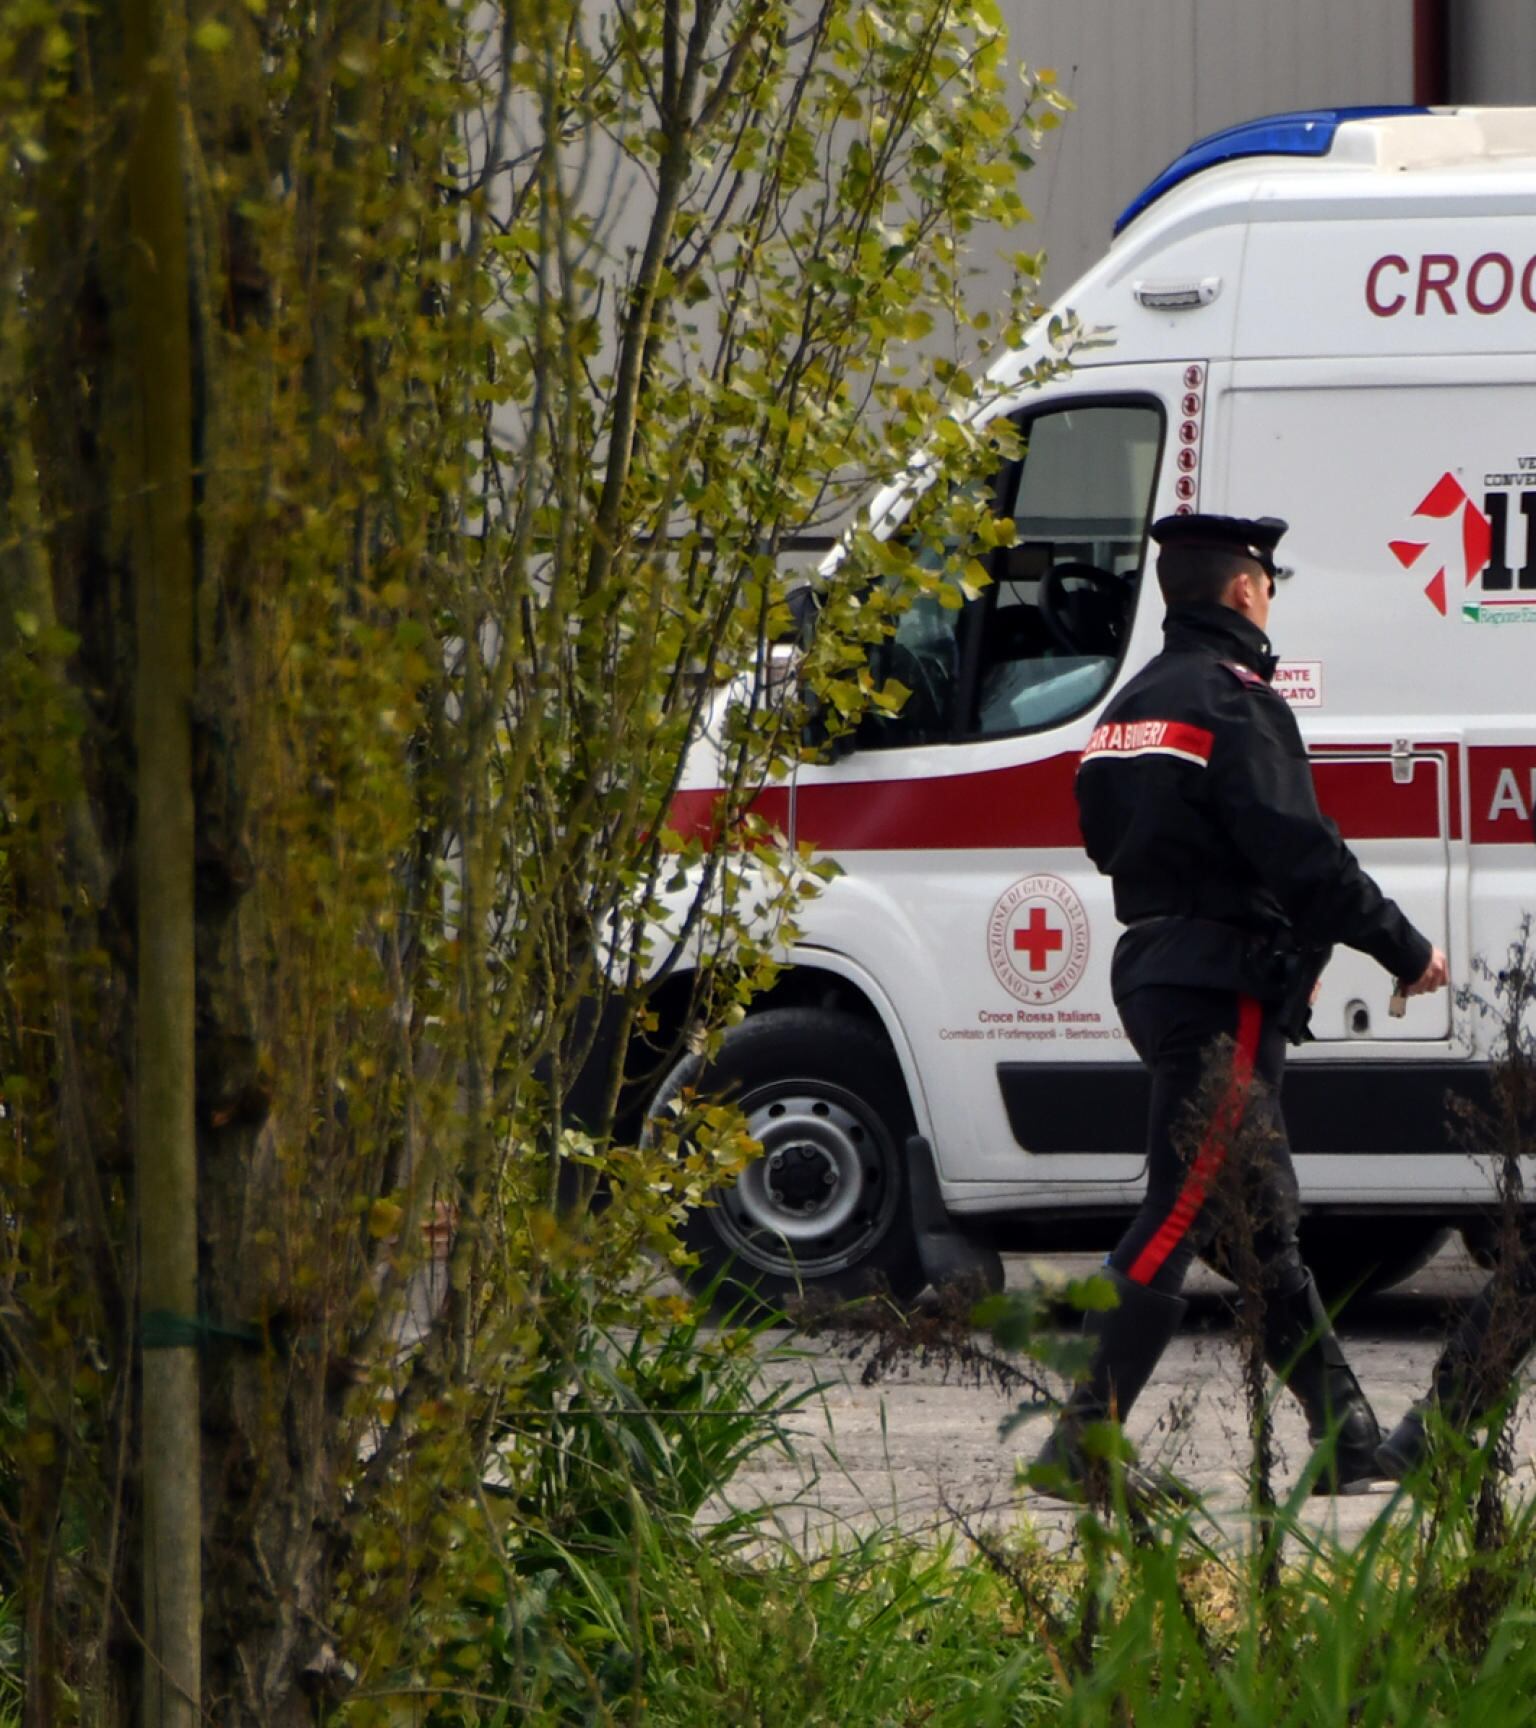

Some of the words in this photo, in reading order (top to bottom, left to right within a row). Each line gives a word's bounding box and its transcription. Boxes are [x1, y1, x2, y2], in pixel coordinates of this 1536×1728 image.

[1275, 669, 1310, 681] ENTE
[978, 1010, 1013, 1023] Croce
[1017, 1010, 1054, 1023] Rossa
[1058, 1010, 1101, 1023] Italiana
[939, 1028, 984, 1040] Comitato
[987, 1028, 995, 1039] di
[1065, 1028, 1110, 1040] Bertinoro
